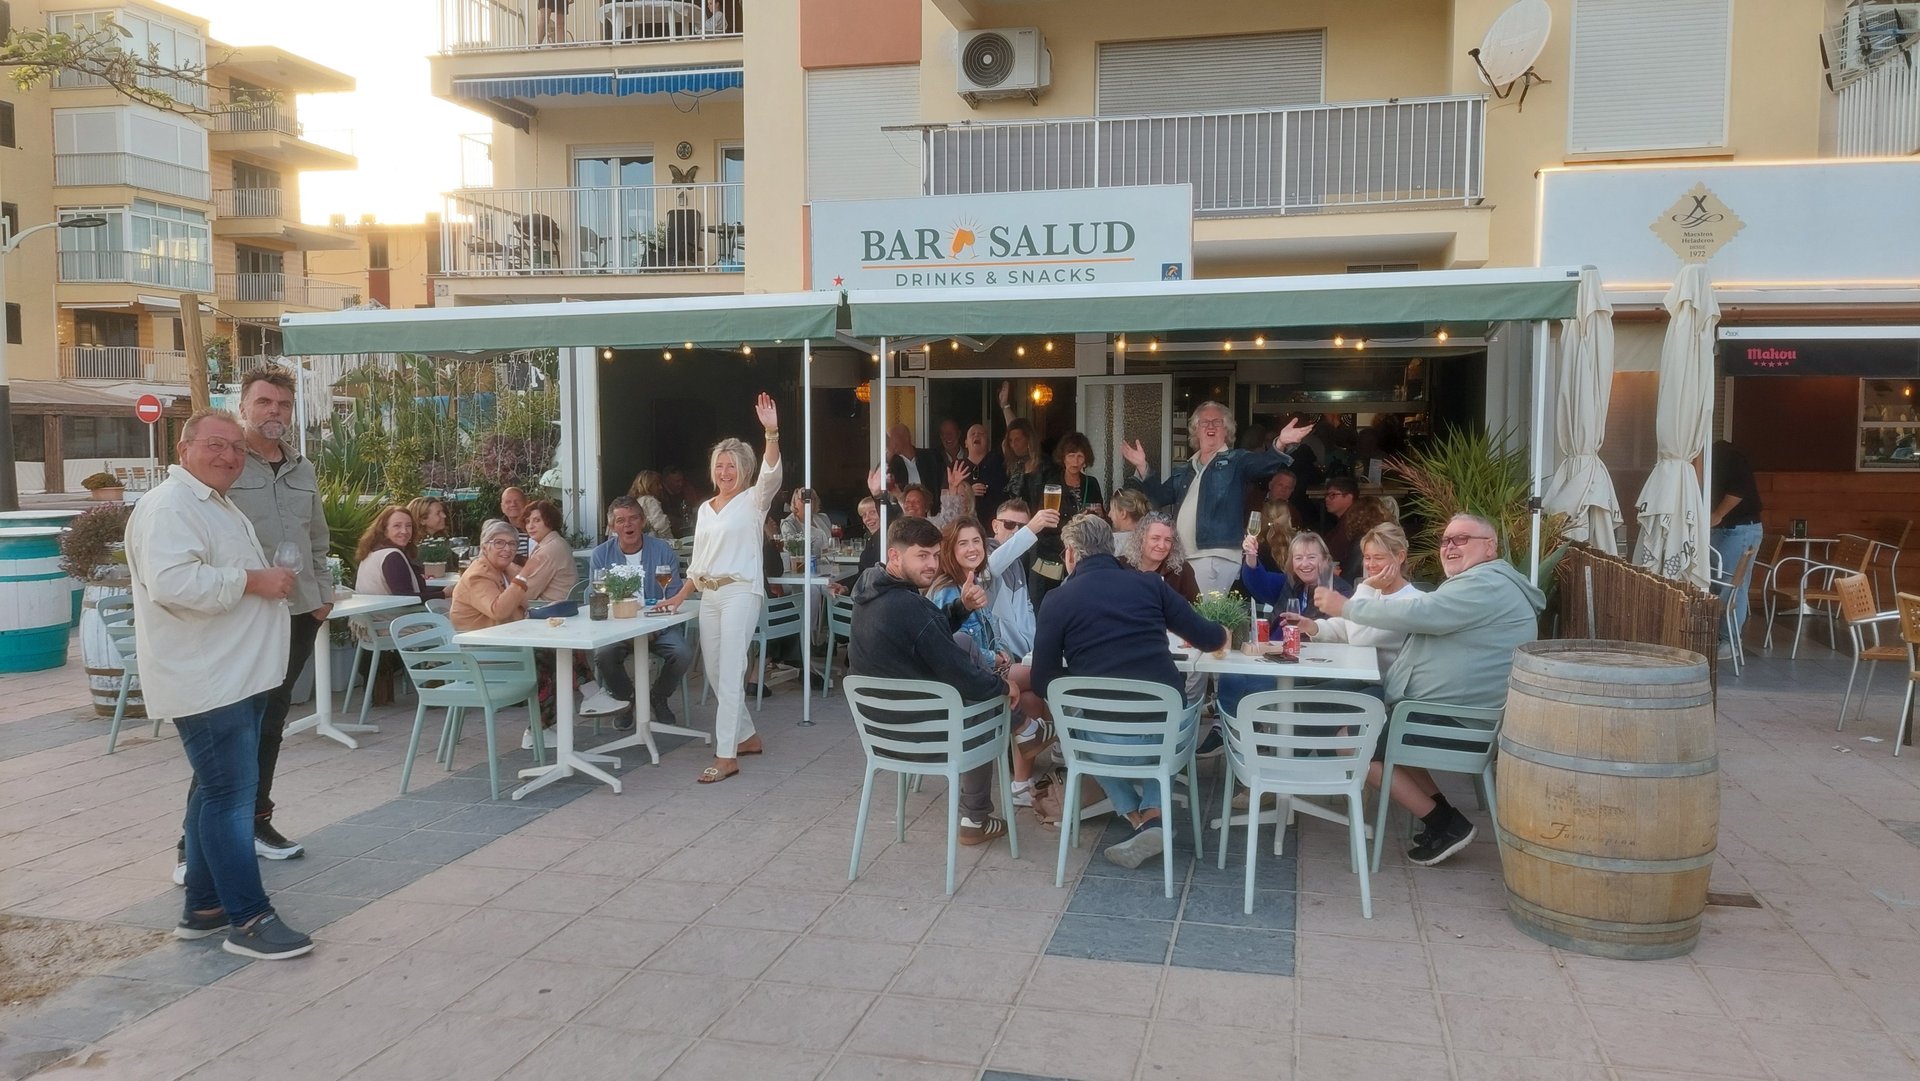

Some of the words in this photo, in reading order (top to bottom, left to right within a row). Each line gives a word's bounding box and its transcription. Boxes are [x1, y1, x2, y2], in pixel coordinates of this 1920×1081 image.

[860, 228, 945, 261] BAR
[989, 220, 1136, 258] SALUD
[1689, 250, 1706, 258] 1972
[896, 271, 975, 287] DRINKS
[986, 271, 997, 285] &
[1008, 267, 1096, 284] SNACKS
[1746, 347, 1797, 360] Mahou
